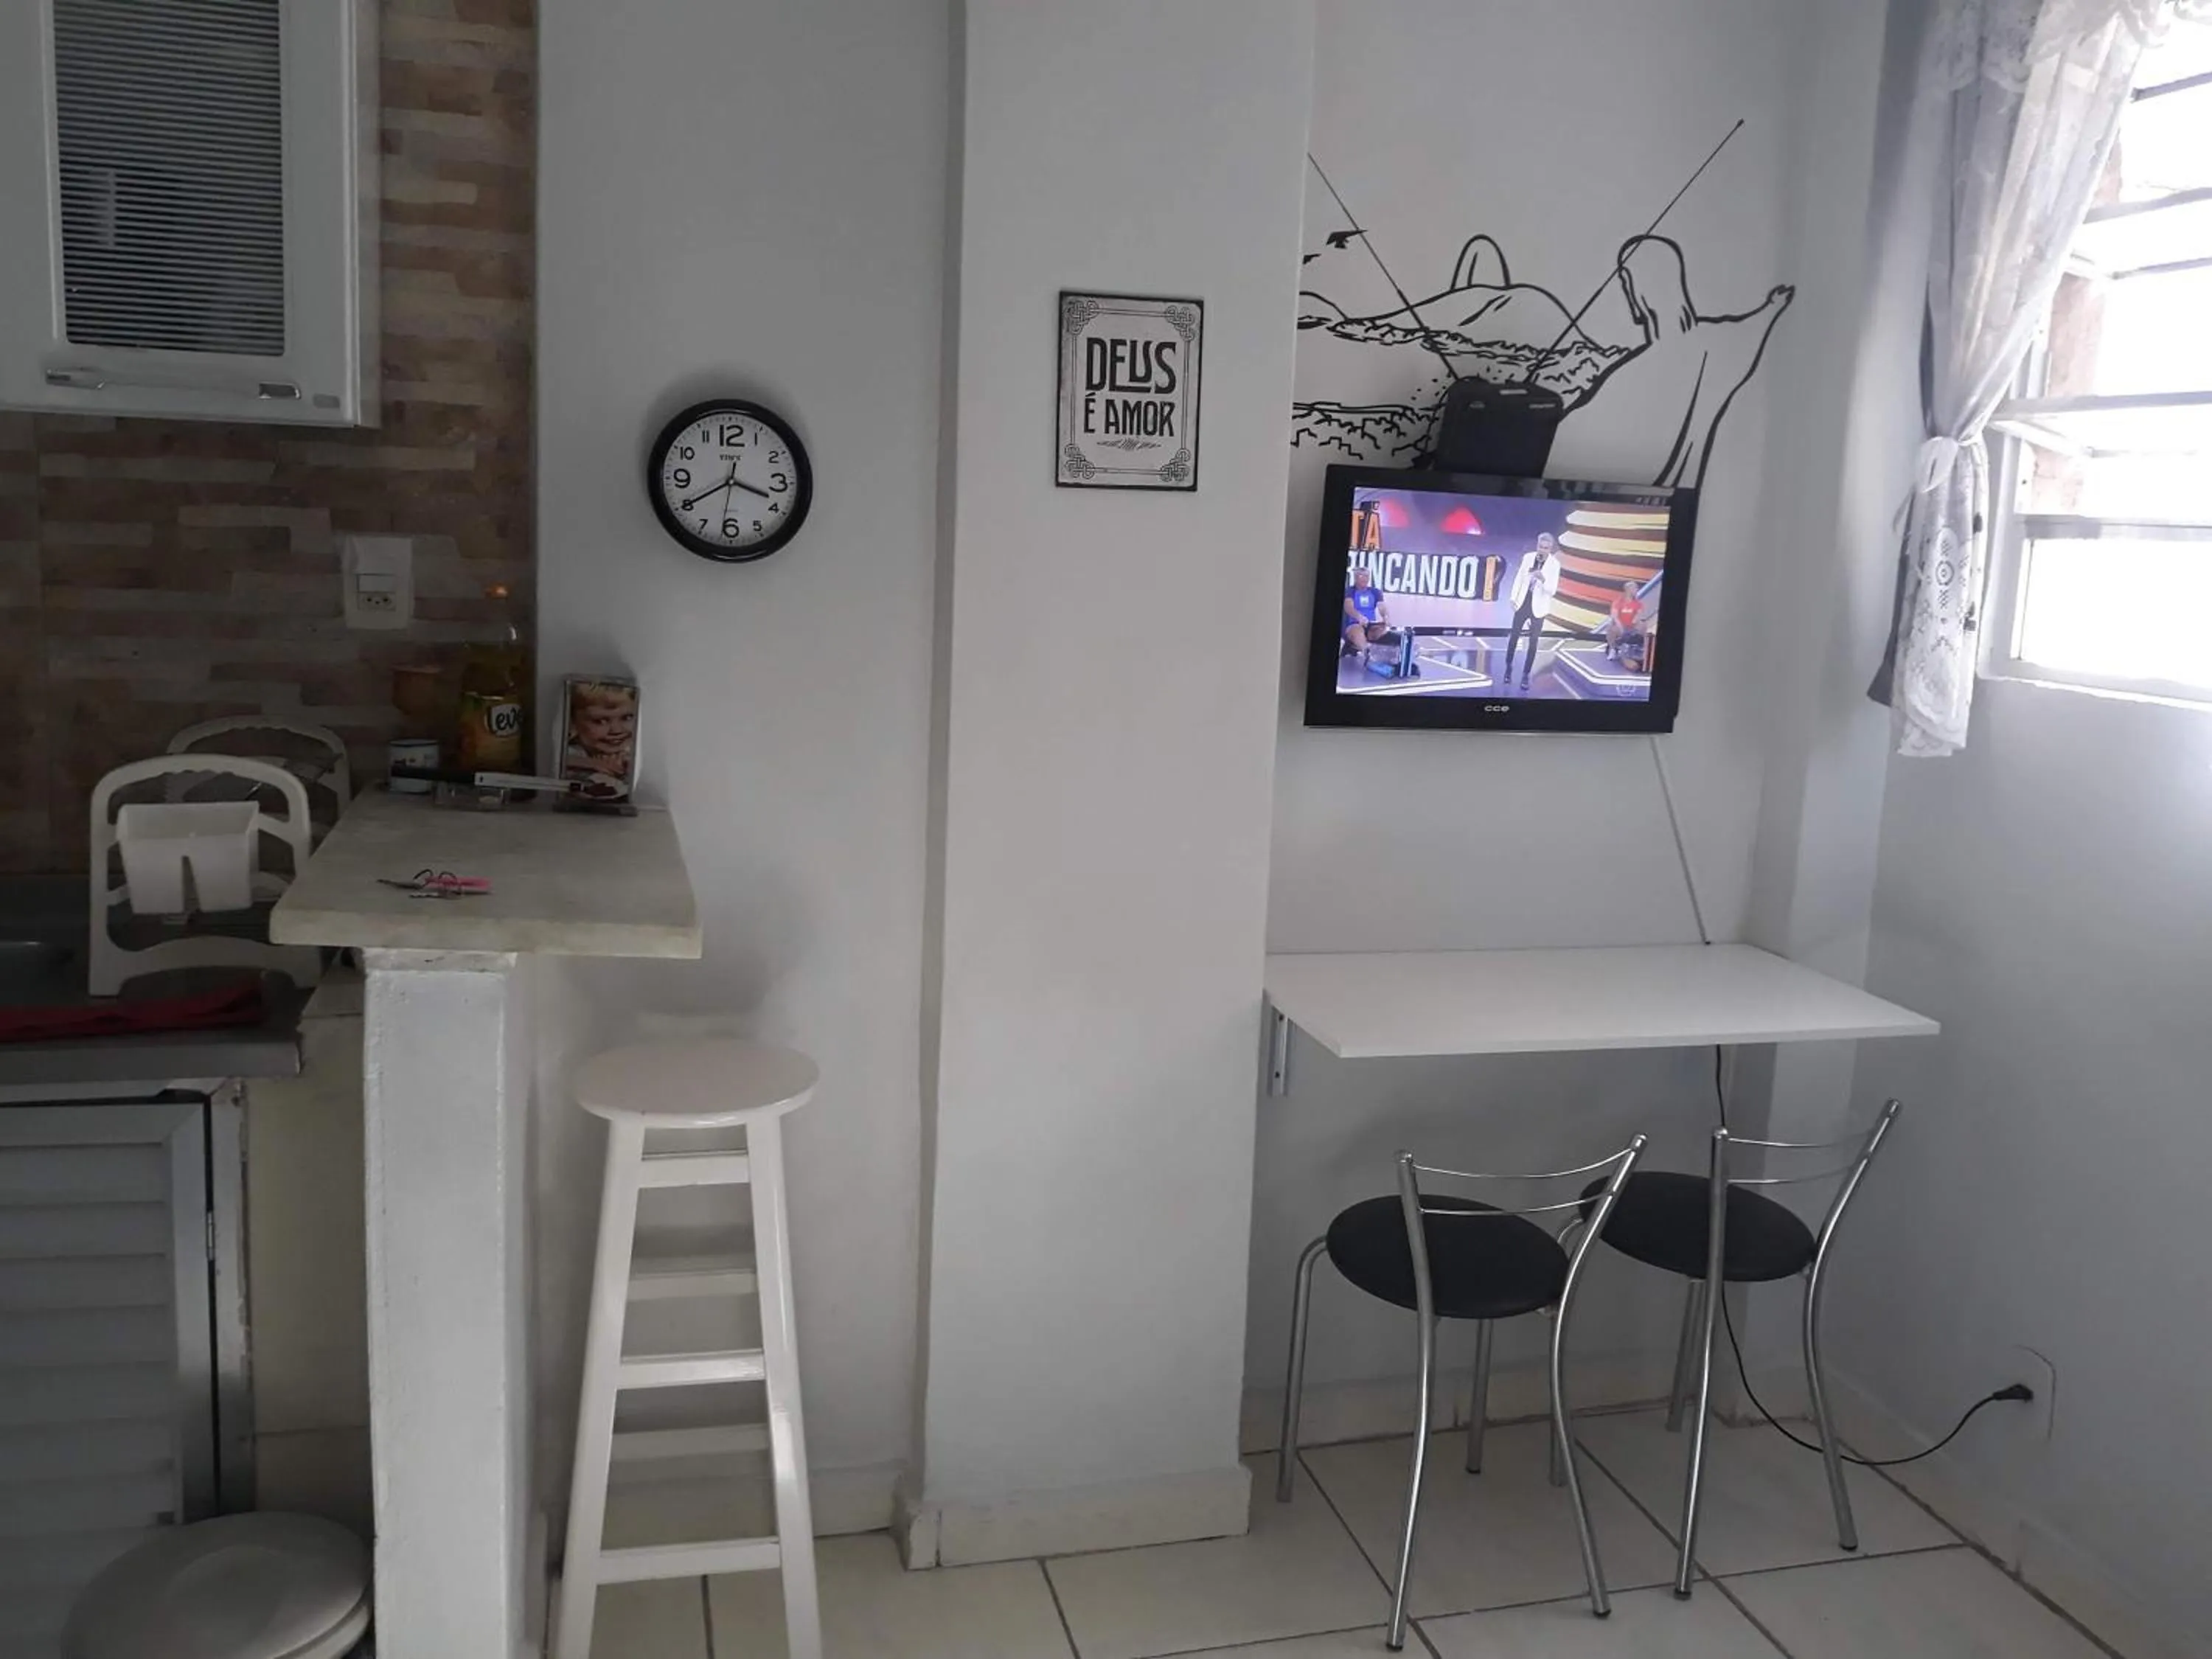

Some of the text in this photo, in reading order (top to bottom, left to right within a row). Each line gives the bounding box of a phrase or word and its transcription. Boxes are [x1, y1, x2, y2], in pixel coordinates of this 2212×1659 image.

[1085, 337, 1177, 394] DEUS
[1084, 392, 1176, 437] É AMOR
[702, 430, 710, 443] 11
[719, 425, 745, 447] 12
[754, 432, 758, 446] 1
[680, 446, 695, 460] 10
[768, 451, 779, 463] 2
[673, 468, 691, 488] 9
[769, 473, 788, 493] 3
[681, 499, 694, 511] 8
[768, 503, 779, 513] 4
[700, 518, 709, 529] 7
[723, 518, 740, 538] 6
[753, 521, 762, 532] 5
